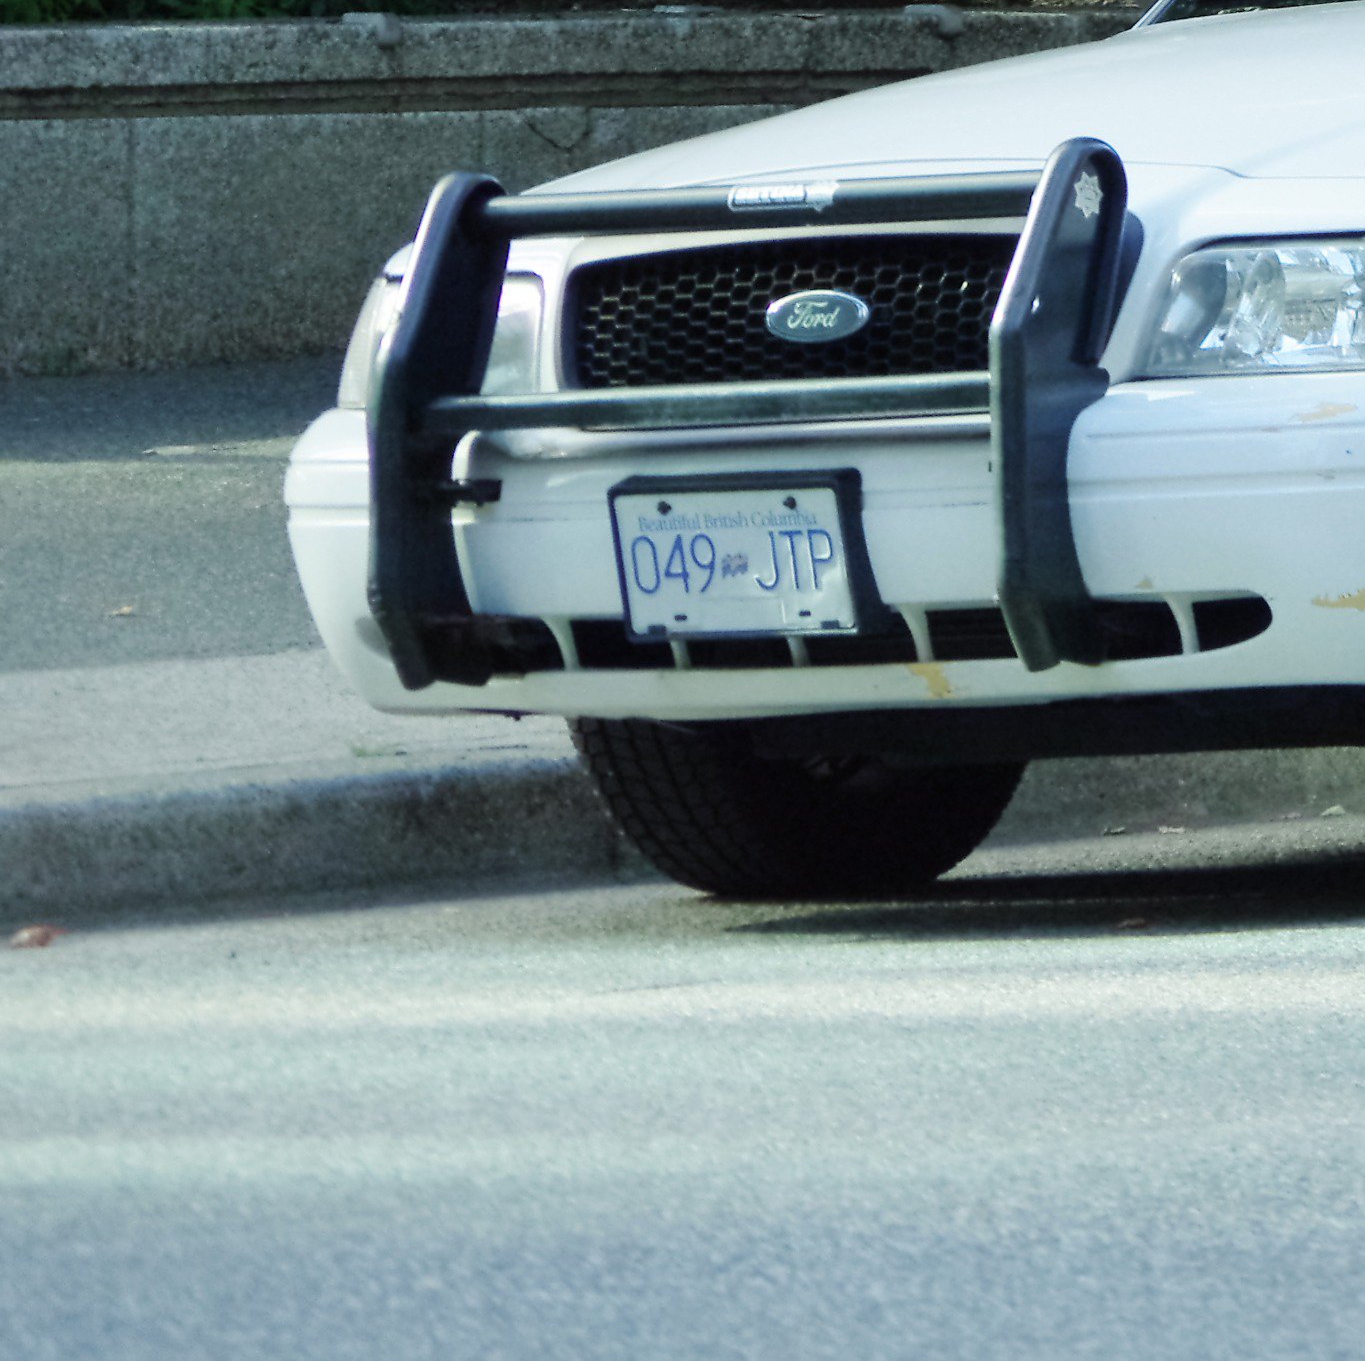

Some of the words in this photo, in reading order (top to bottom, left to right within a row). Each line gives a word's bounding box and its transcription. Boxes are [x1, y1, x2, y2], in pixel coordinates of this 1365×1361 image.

[786, 301, 840, 330] Ford
[638, 512, 700, 532] Beautiful
[704, 511, 750, 529] British
[750, 508, 818, 527] Columbia
[631, 533, 717, 595] 049
[752, 528, 834, 591] JTP
